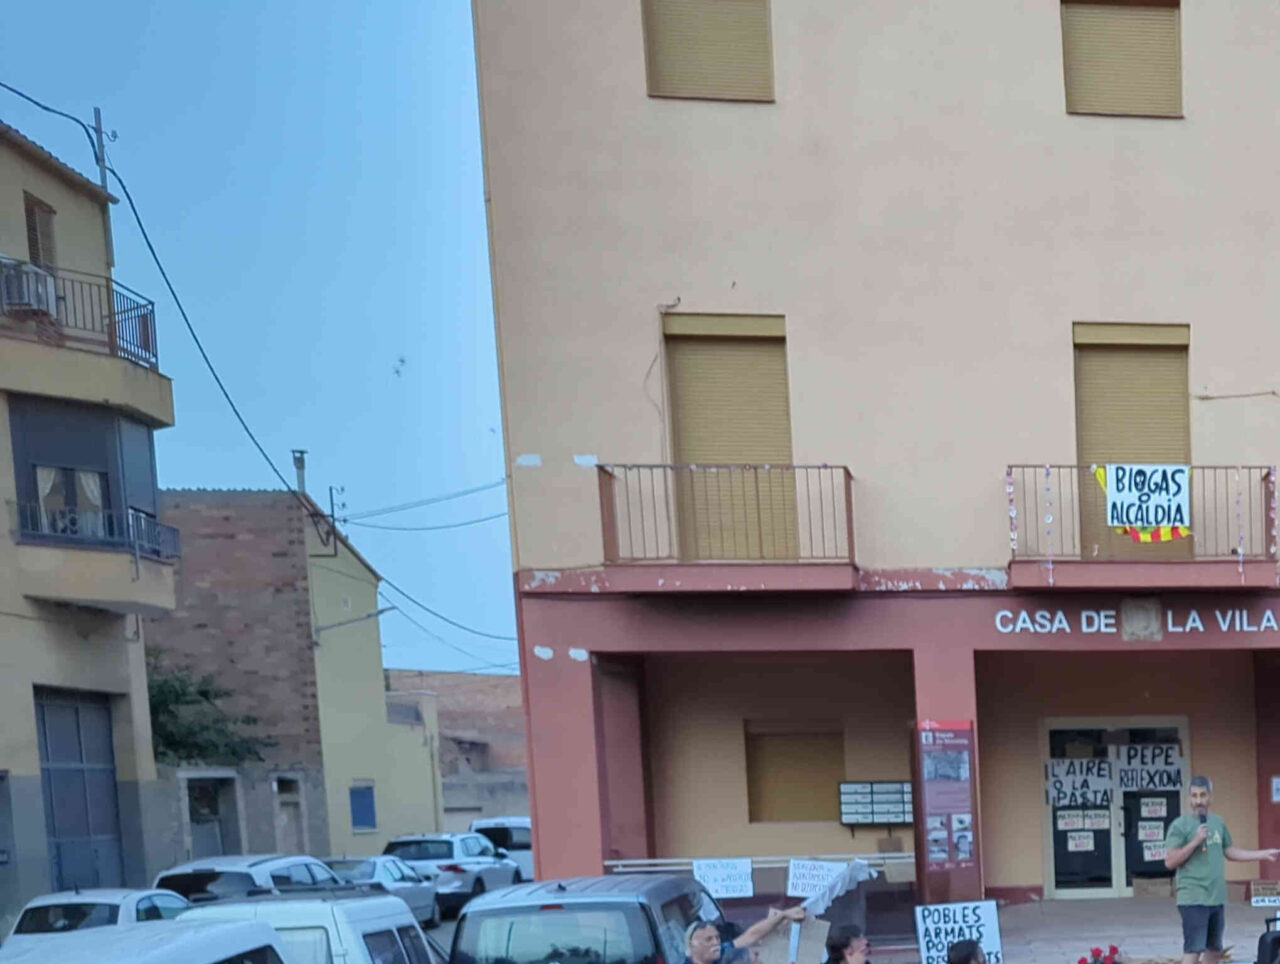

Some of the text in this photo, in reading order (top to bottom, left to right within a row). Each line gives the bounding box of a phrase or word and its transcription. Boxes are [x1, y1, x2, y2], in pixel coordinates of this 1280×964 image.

[1115, 466, 1186, 497] BIOGAS
[995, 609, 1279, 633] CASA DE LA VILA
[1126, 746, 1175, 767] PEPE
[1072, 778, 1090, 791] LA
[1119, 768, 1183, 788] REFLEXIONA
[921, 906, 982, 925] POBLES
[923, 923, 985, 942] ARMATS
